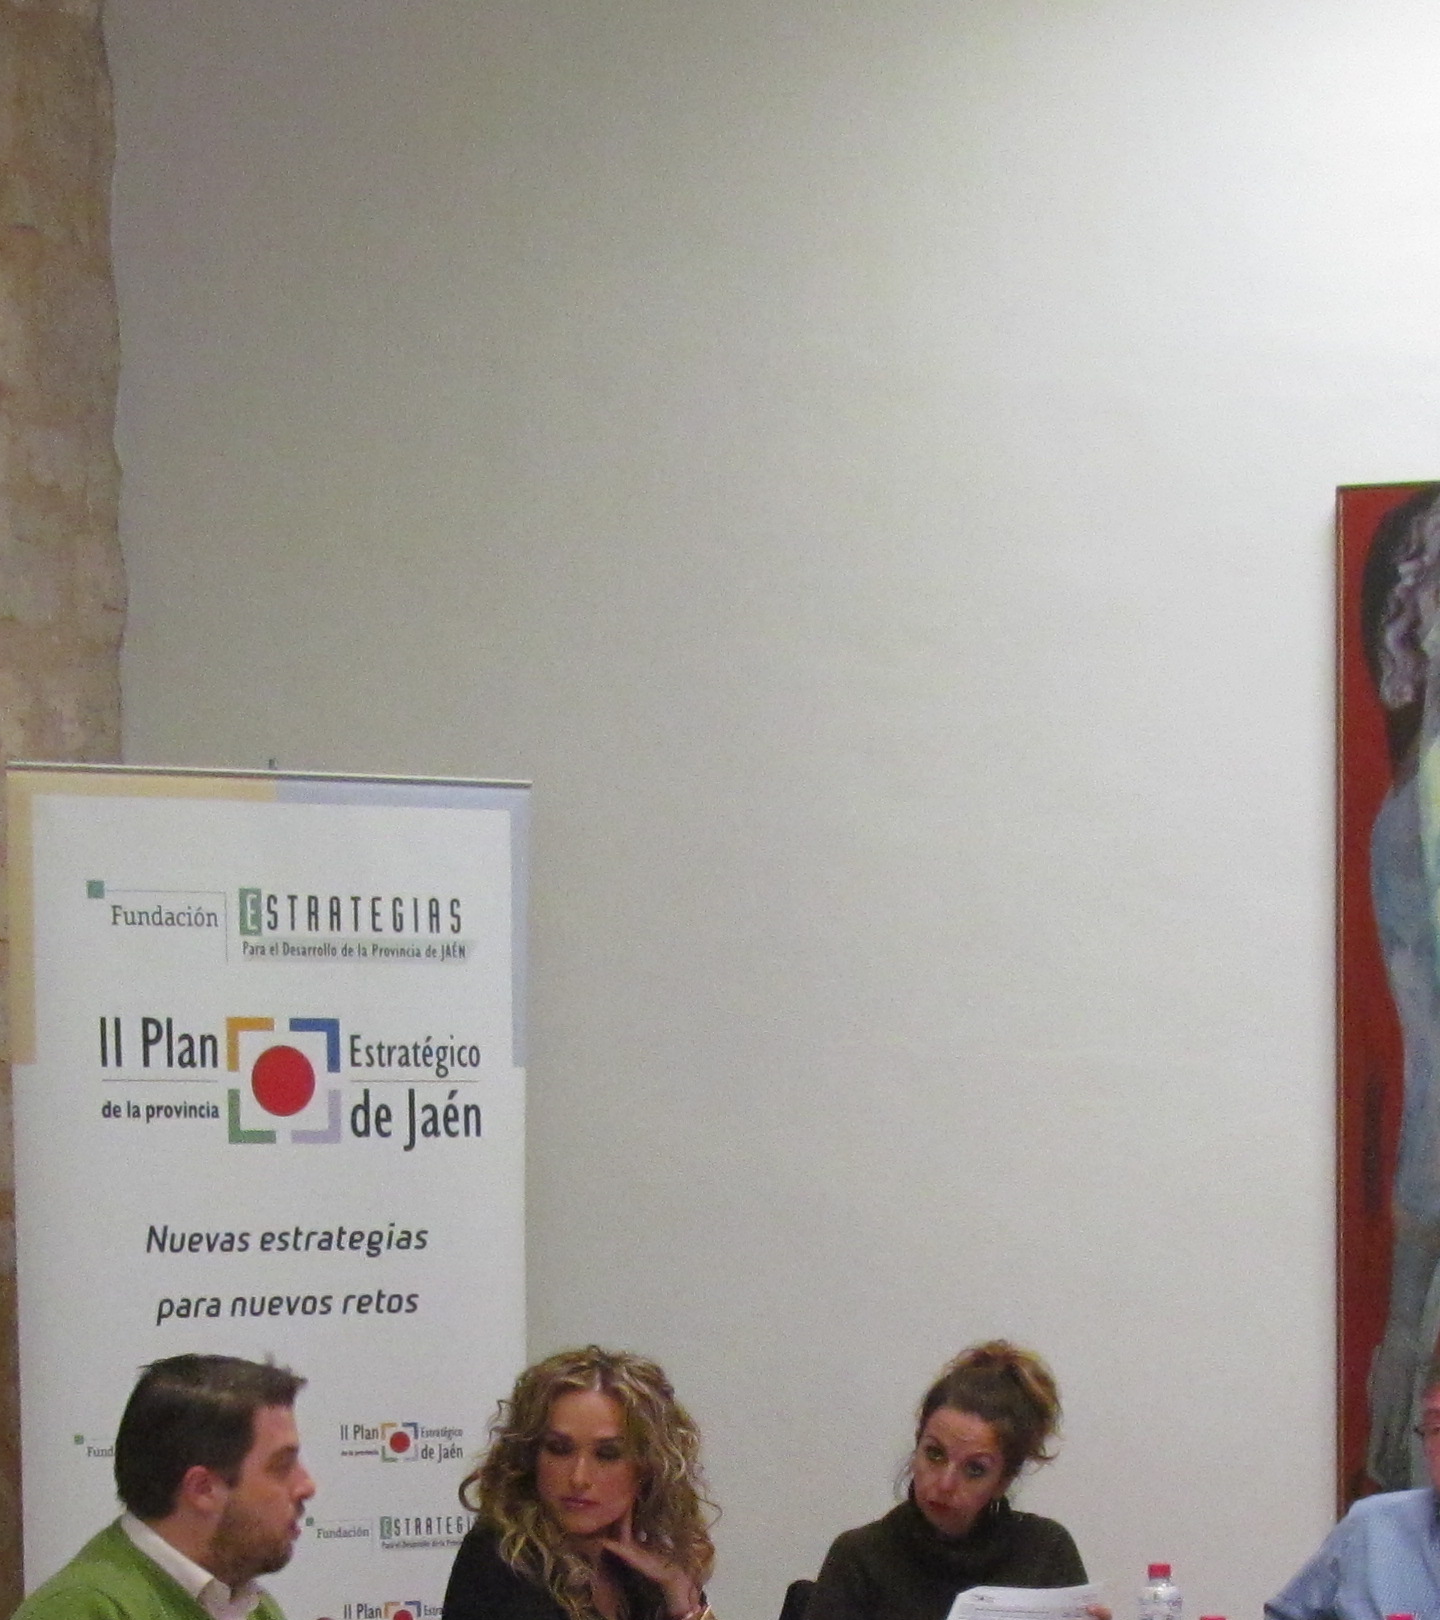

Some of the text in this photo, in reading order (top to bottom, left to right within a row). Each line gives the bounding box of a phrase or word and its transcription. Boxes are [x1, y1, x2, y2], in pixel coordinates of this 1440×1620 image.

[111, 904, 219, 928] Fundación
[245, 894, 461, 934] ESTRATEGIAS
[243, 941, 466, 963] Para el Desarrollo de la Provincia de JAÉN
[100, 1016, 482, 1079] II Plan Estratégico
[101, 1101, 221, 1125] de la provincia
[348, 1087, 483, 1152] de Jaén
[145, 1222, 430, 1258] Nuevas estrategias
[156, 1287, 420, 1327] para nuevos retos
[353, 1424, 379, 1441] Plan
[421, 1444, 435, 1460] de
[437, 1443, 464, 1464] Jaén
[316, 1527, 370, 1540] Fundación
[356, 1603, 382, 1620] Plan
